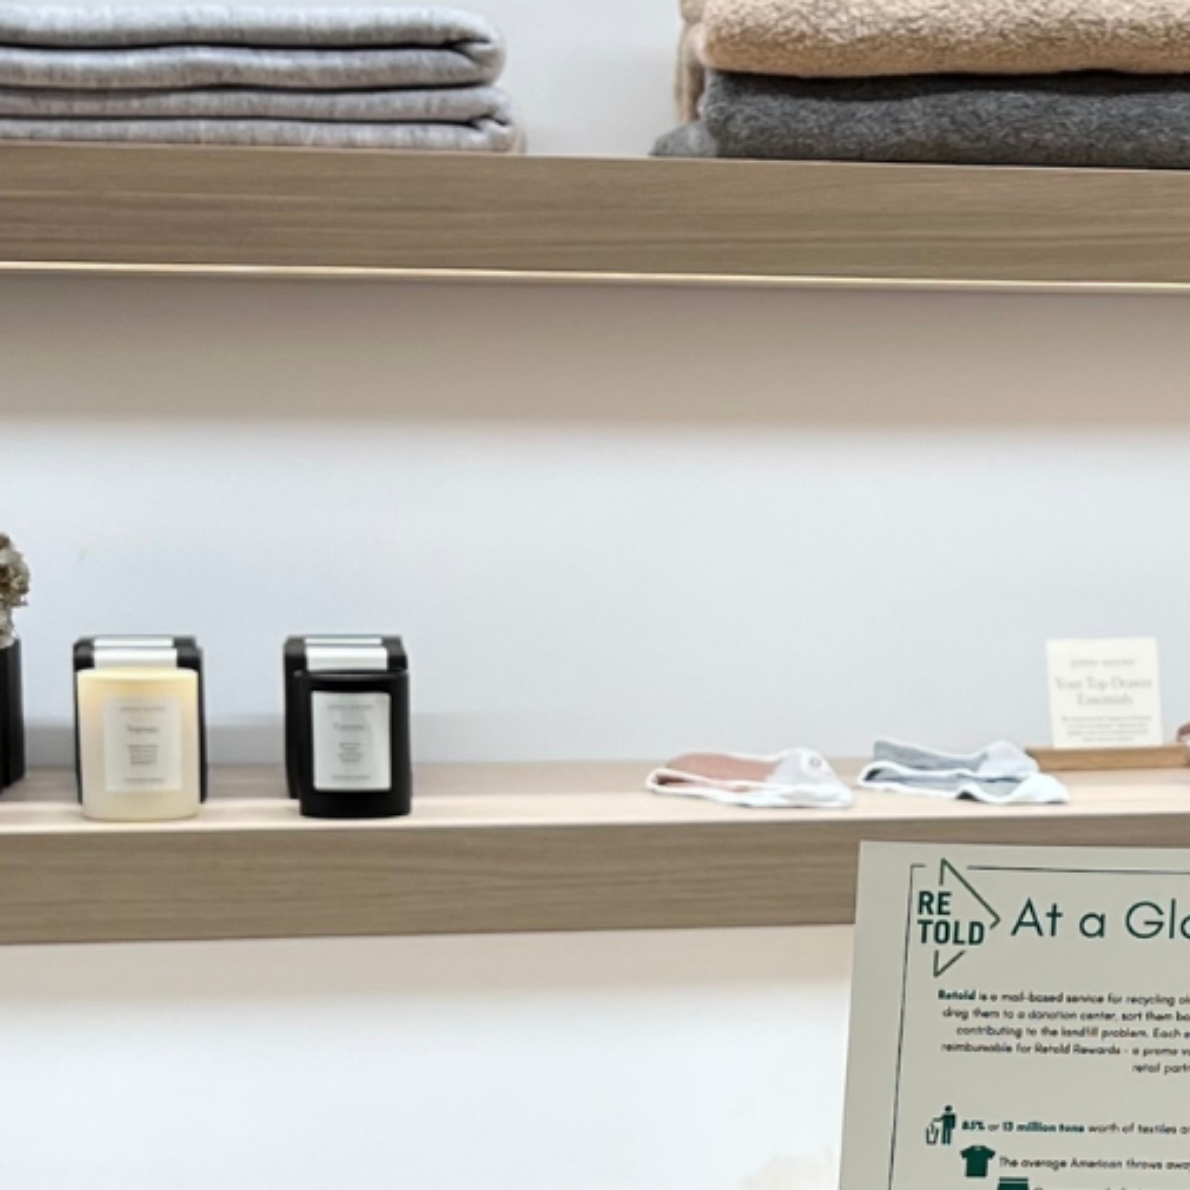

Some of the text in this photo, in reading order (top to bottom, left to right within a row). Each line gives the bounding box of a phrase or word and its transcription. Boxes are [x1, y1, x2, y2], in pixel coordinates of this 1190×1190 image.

[918, 891, 952, 915] RE
[1011, 898, 1062, 938] At
[1079, 913, 1106, 938] a
[917, 920, 984, 945] TOLD
[1000, 1156, 1018, 1167] The
[1021, 1159, 1067, 1171] average
[1071, 1157, 1122, 1168] American
[1126, 1158, 1162, 1169] throws
